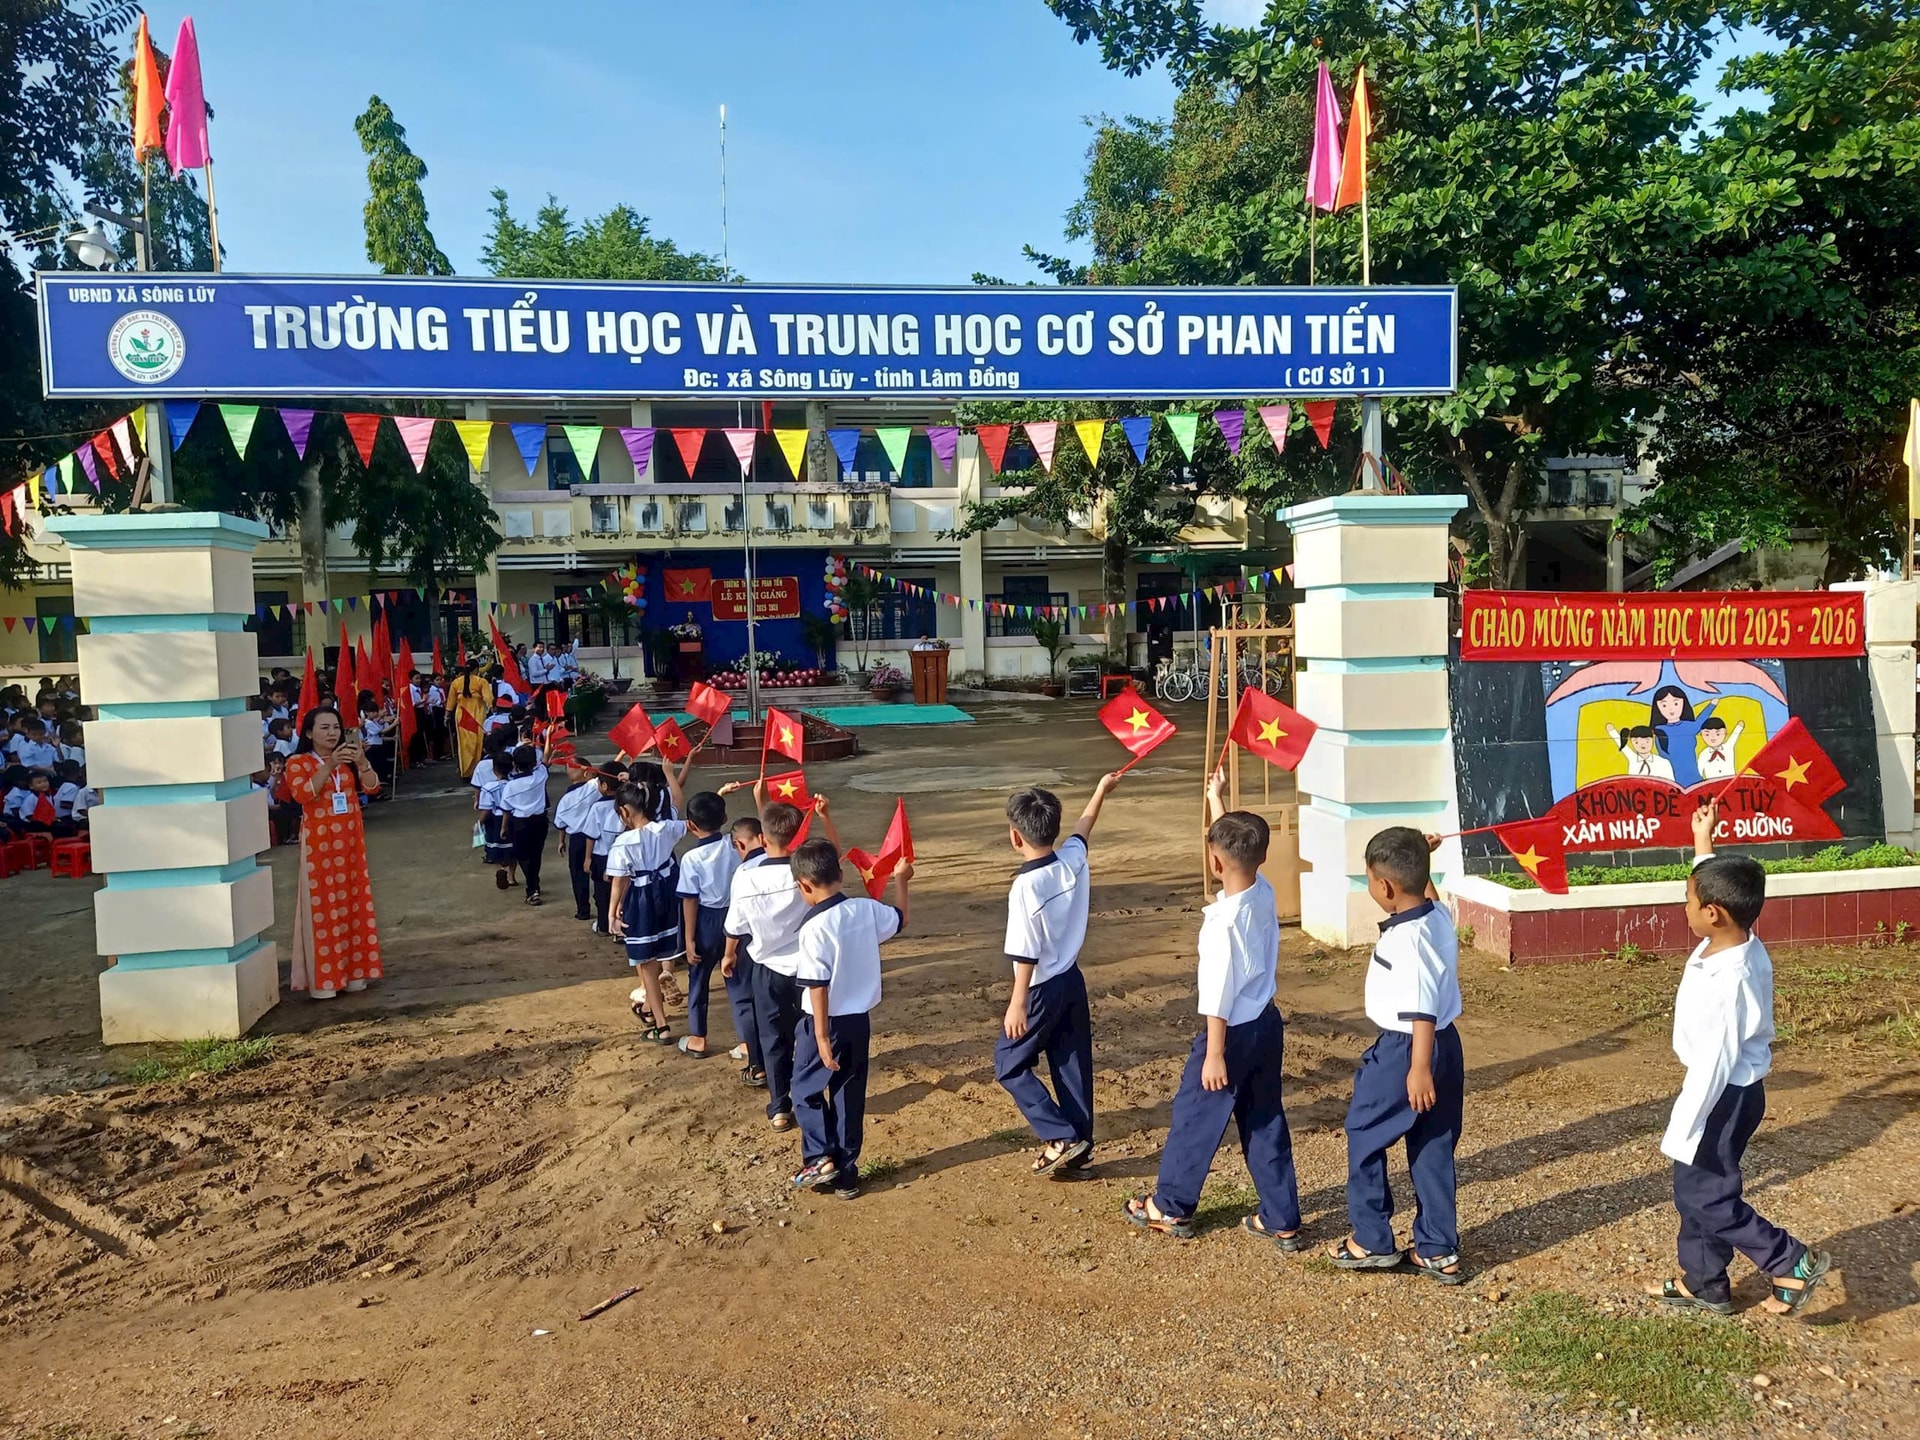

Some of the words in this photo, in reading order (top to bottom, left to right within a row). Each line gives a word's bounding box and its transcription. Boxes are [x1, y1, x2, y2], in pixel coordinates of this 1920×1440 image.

[69, 287, 111, 303] UBND
[116, 285, 138, 303] XÃ
[142, 285, 185, 303] SÔNG
[188, 285, 216, 303] LŨY
[245, 294, 449, 351] TRƯỜNG
[462, 290, 570, 354] TIỂU
[587, 312, 682, 364] HỌC
[695, 305, 757, 354] VÀ
[770, 313, 920, 356] TRUNG
[935, 314, 1022, 365] HỌC
[1037, 312, 1095, 356] CƠ
[1108, 300, 1165, 356] SỞ
[1179, 313, 1292, 355] PHAN
[1305, 302, 1395, 355] TIẾN
[683, 369, 719, 388] Đc:
[727, 369, 753, 388] xã
[760, 368, 812, 390] Sông
[818, 369, 854, 390] Lũy
[875, 367, 914, 388] tỉnh
[921, 368, 963, 387] Lâm
[968, 364, 1020, 389] Đồng
[1470, 596, 1525, 648] CHÀO
[1531, 596, 1595, 648] MỪNG
[1600, 598, 1647, 647] NĂM
[1652, 607, 1694, 657] HỌC
[1698, 596, 1737, 647] MỚI
[1743, 607, 1791, 647] 2025
[1797, 624, 1804, 633] -
[1809, 606, 1857, 646] 2026
[1576, 786, 1648, 819] KHÔNG
[1735, 781, 1777, 813] TÚY
[1562, 818, 1604, 846] XÂM
[1609, 813, 1661, 843] NHẬP
[1733, 811, 1794, 838] ĐƯỜNG
